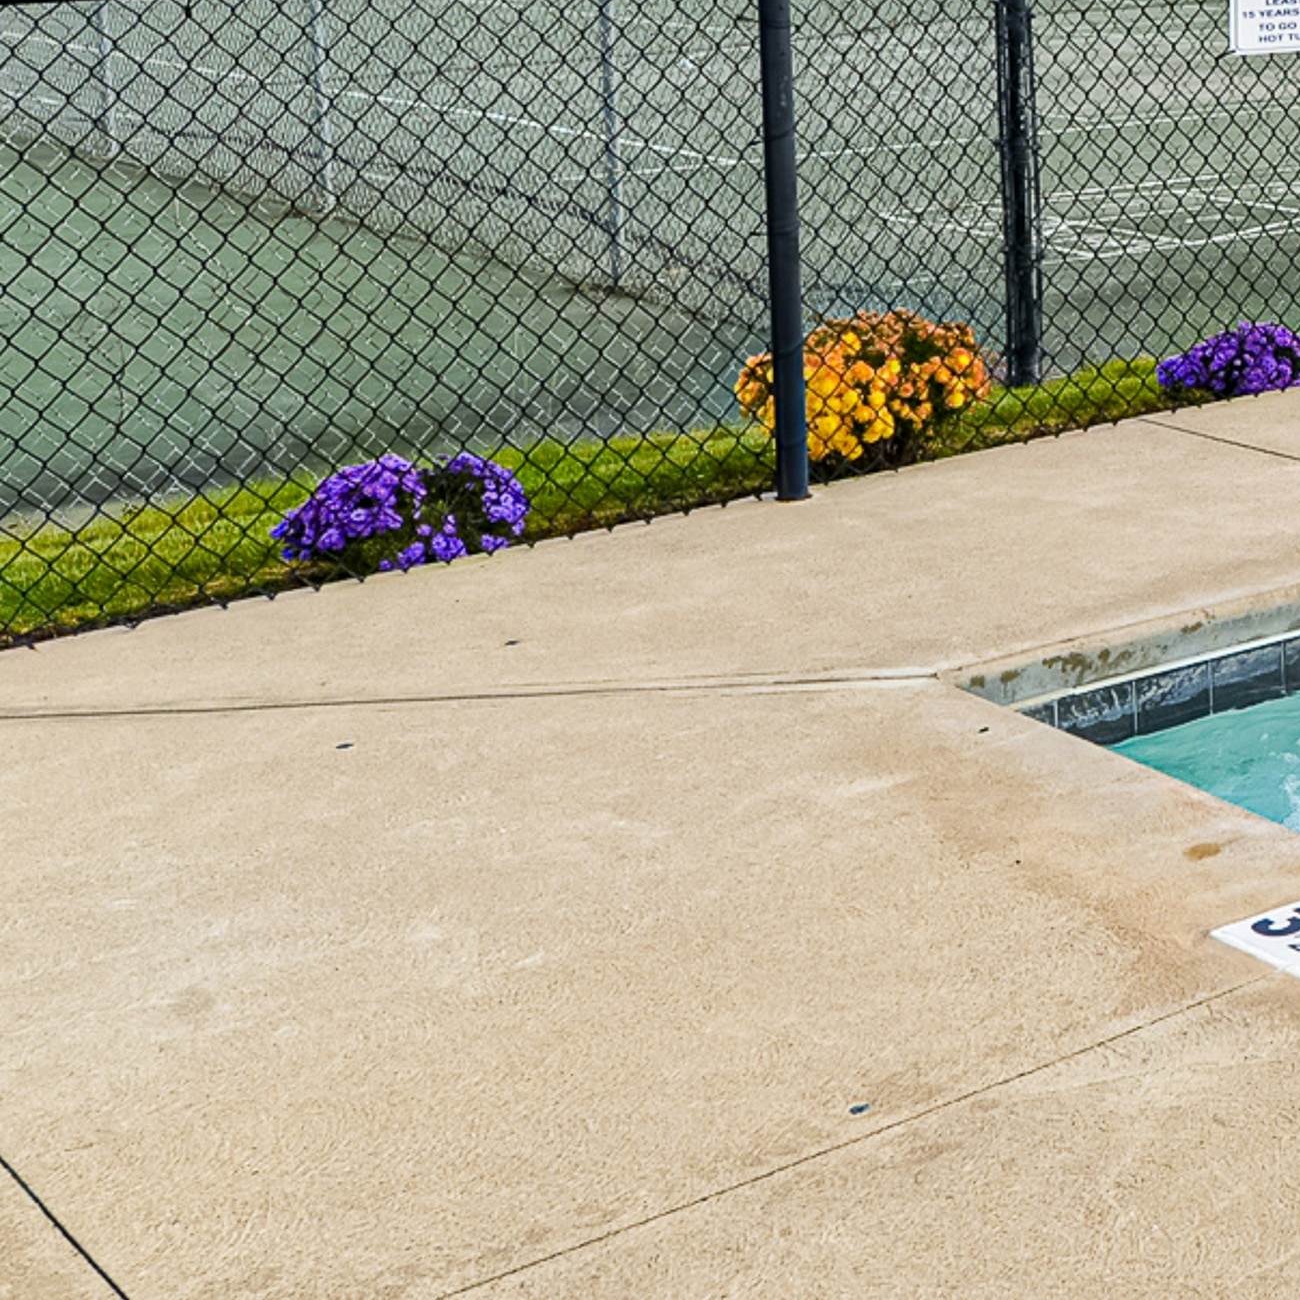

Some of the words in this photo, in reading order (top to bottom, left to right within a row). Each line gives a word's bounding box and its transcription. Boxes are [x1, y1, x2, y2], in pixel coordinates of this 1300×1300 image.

[1259, 8, 1299, 18] YEARS
[1259, 23, 1275, 32] TO
[1278, 21, 1297, 30] GO
[1259, 33, 1283, 43] HOT
